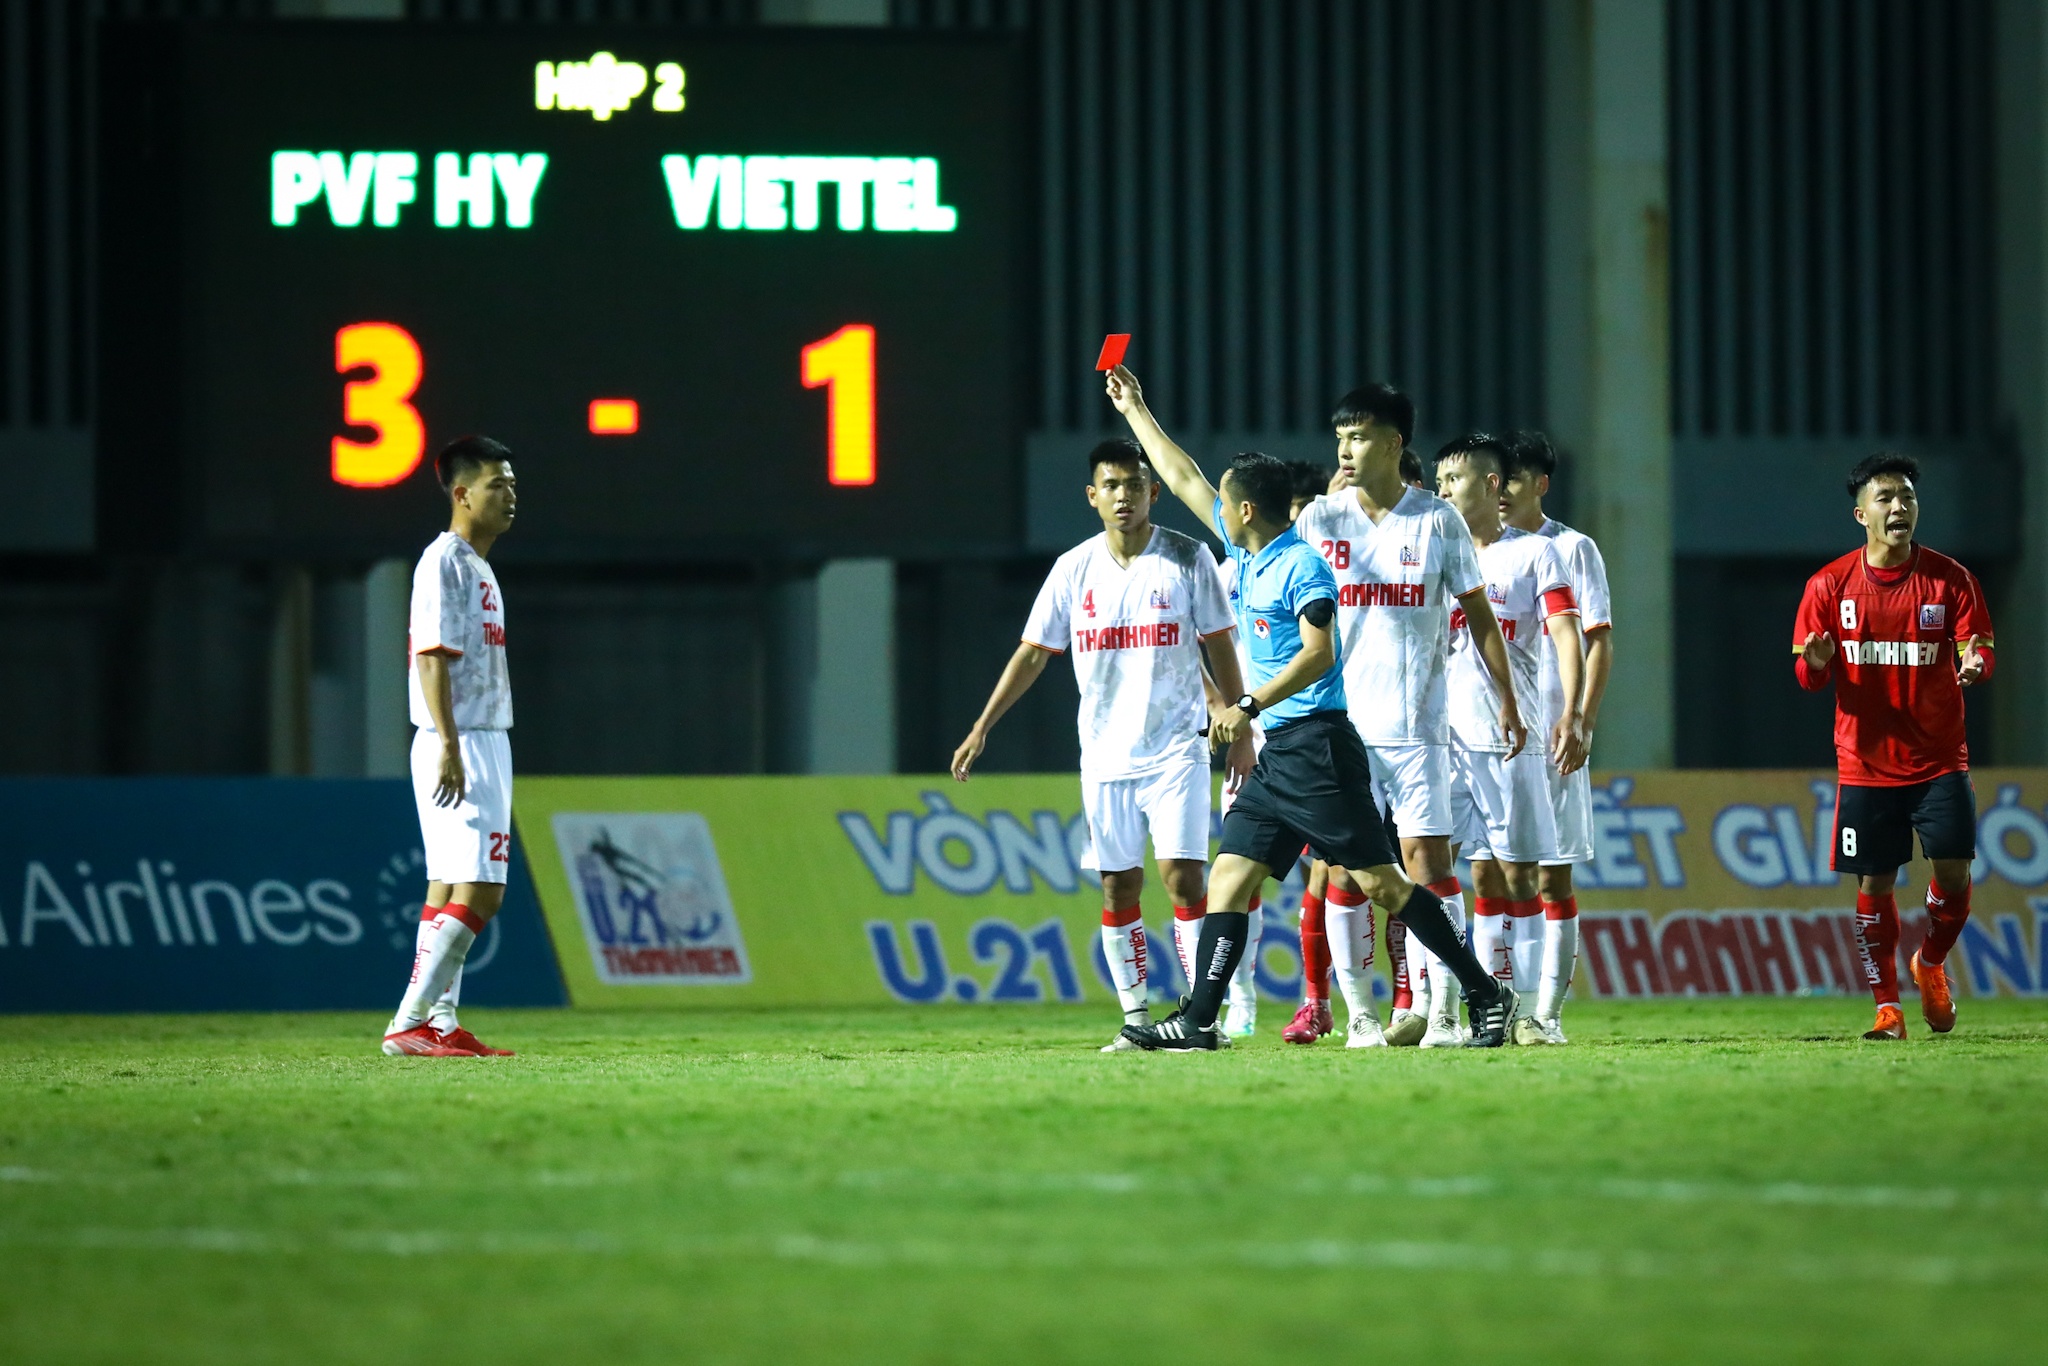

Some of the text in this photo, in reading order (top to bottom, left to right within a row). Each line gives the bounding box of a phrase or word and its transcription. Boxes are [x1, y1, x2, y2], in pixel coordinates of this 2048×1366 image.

[652, 62, 686, 112] 2
[271, 150, 549, 229] PVF HY
[662, 153, 959, 233] VIETTEL
[331, 321, 427, 489] 3
[800, 323, 877, 487] 1
[1321, 540, 1351, 570] 28
[1083, 589, 1096, 618] 4
[1840, 599, 1857, 630] 8
[1842, 827, 1857, 857] 8
[20, 859, 365, 946] Airlines
[866, 919, 1085, 1003] U.21
[1206, 936, 1234, 981] JOGARBOLA
